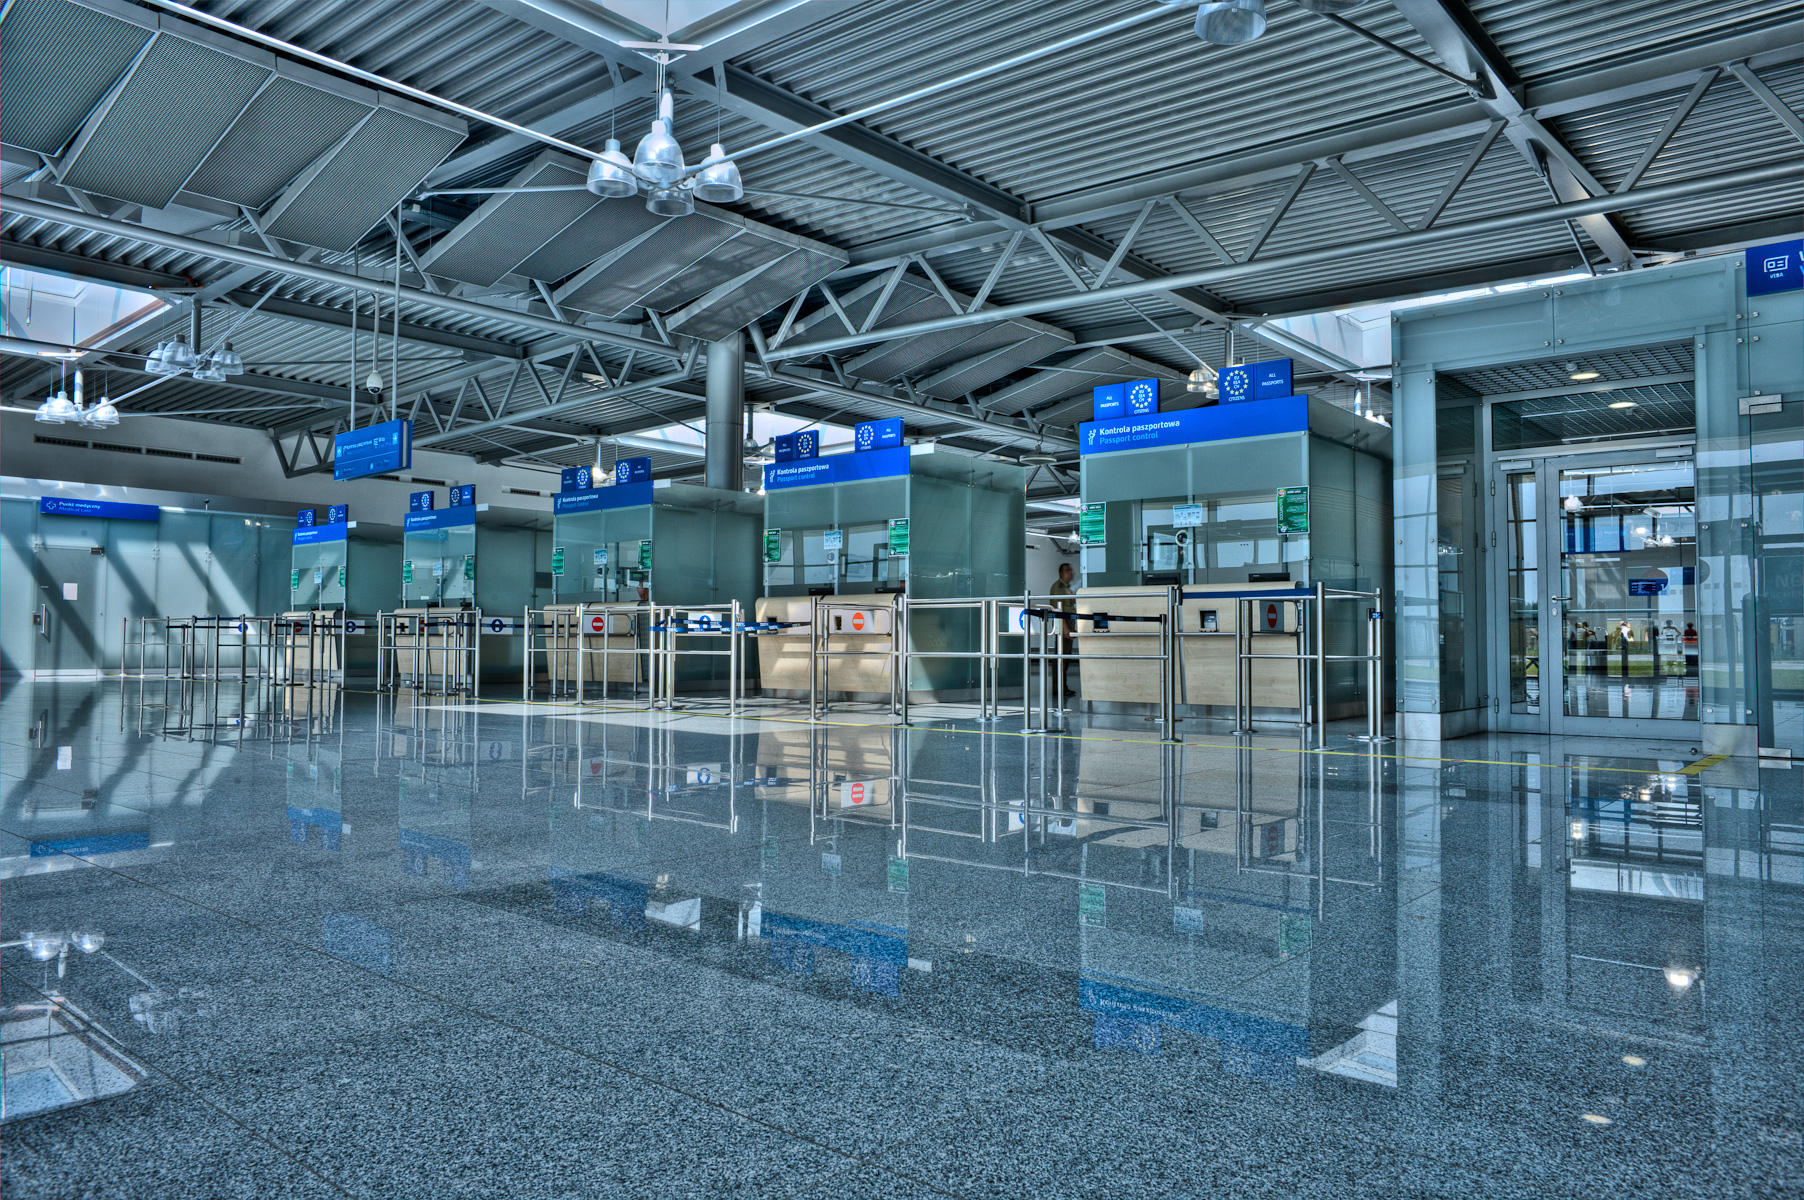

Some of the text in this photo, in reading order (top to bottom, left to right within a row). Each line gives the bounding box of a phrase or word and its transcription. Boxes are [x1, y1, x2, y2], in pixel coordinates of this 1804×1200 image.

[1261, 378, 1284, 387] PASSPORTS
[1099, 420, 1180, 436] Kontrola paszportowa
[1099, 431, 1159, 445] Passport control
[776, 463, 830, 476] Kontrola paszportowa
[776, 471, 816, 483] Passport control
